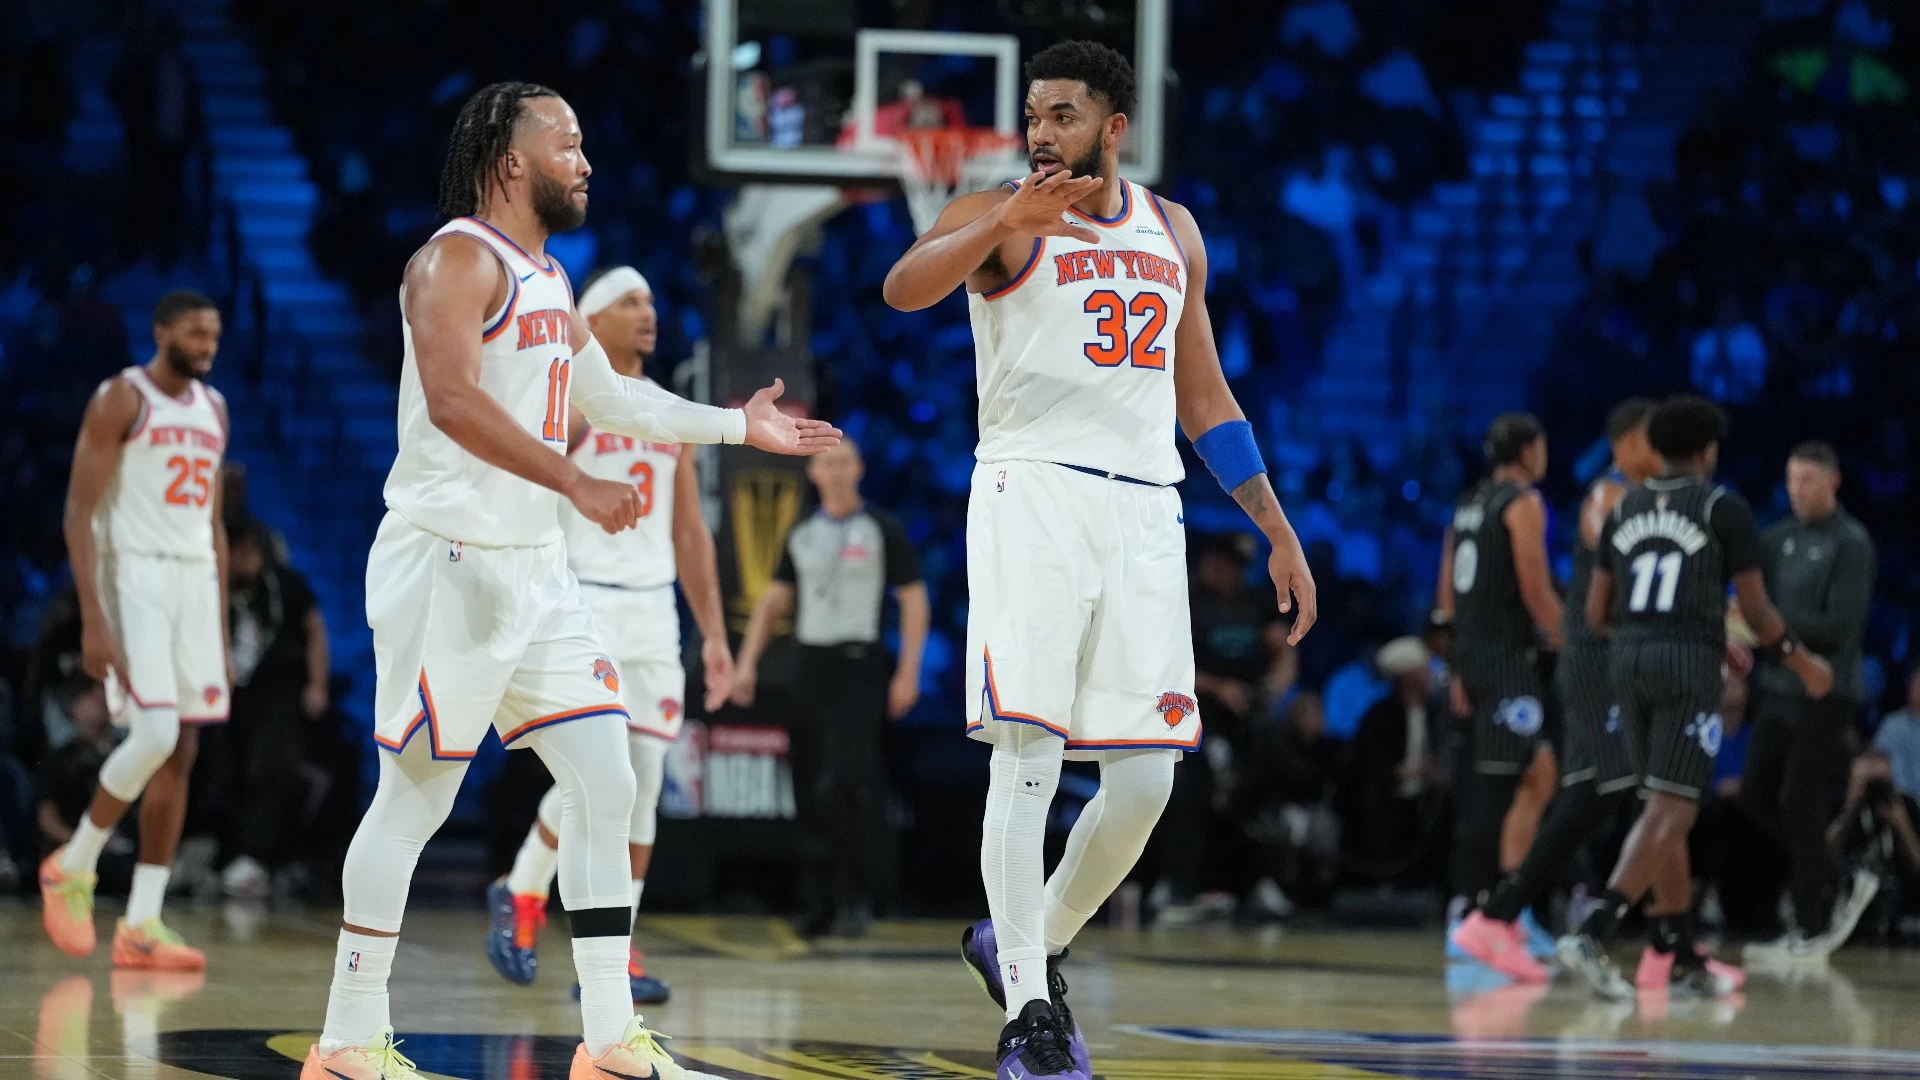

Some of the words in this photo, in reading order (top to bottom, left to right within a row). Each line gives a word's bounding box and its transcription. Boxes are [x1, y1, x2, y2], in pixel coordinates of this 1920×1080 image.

[1054, 249, 1115, 287] NEW
[1117, 250, 1182, 295] YORK
[517, 309, 558, 351] NEW
[1084, 290, 1167, 371] 32
[543, 357, 569, 442] 11
[165, 455, 212, 508] 25
[629, 462, 653, 516] 3
[1629, 551, 1683, 612] 11
